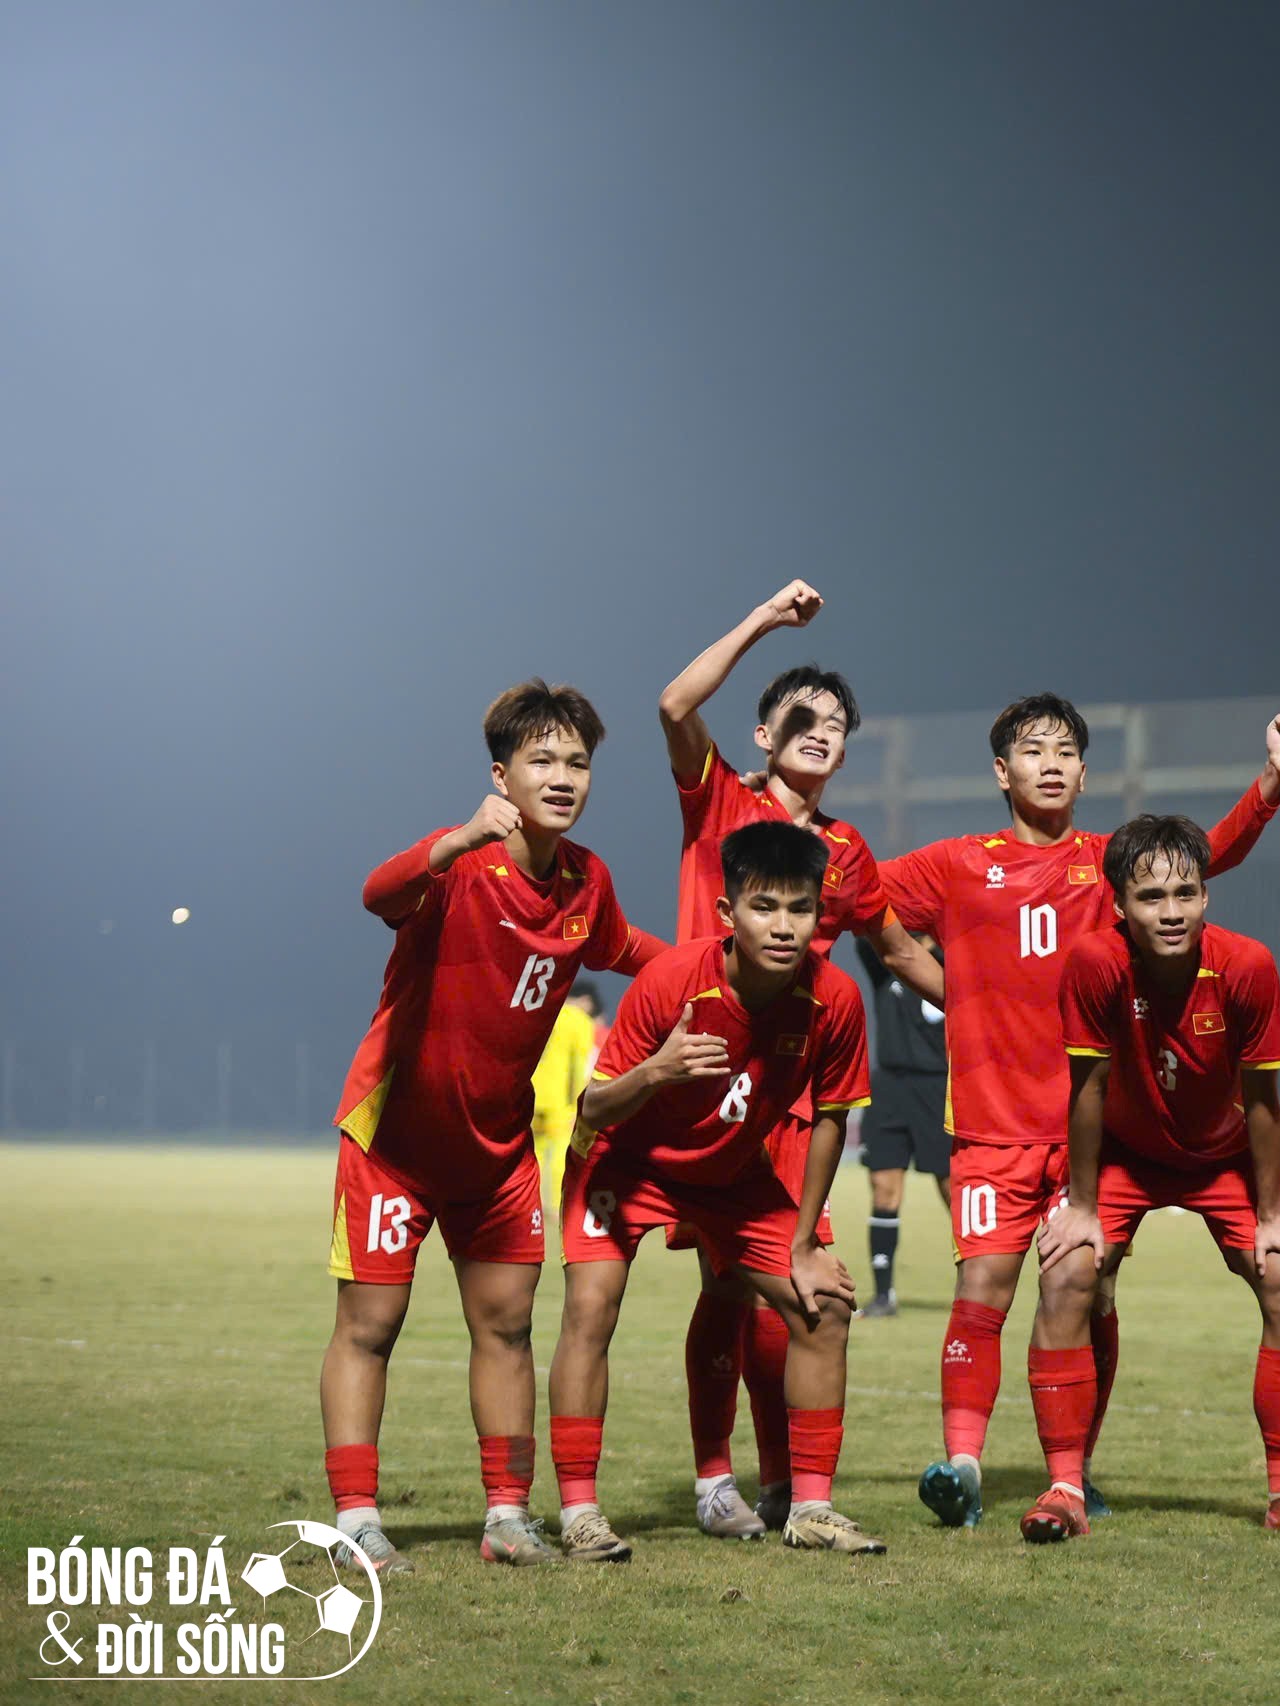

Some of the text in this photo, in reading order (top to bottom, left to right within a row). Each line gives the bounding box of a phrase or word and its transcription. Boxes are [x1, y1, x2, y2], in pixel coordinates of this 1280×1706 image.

[1019, 903, 1057, 959] 10
[510, 954, 555, 1012] 13
[719, 1072, 752, 1123] 8
[1155, 1048, 1178, 1092] 3
[367, 1193, 411, 1254] 13
[582, 1190, 617, 1238] 8
[961, 1183, 997, 1239] 10
